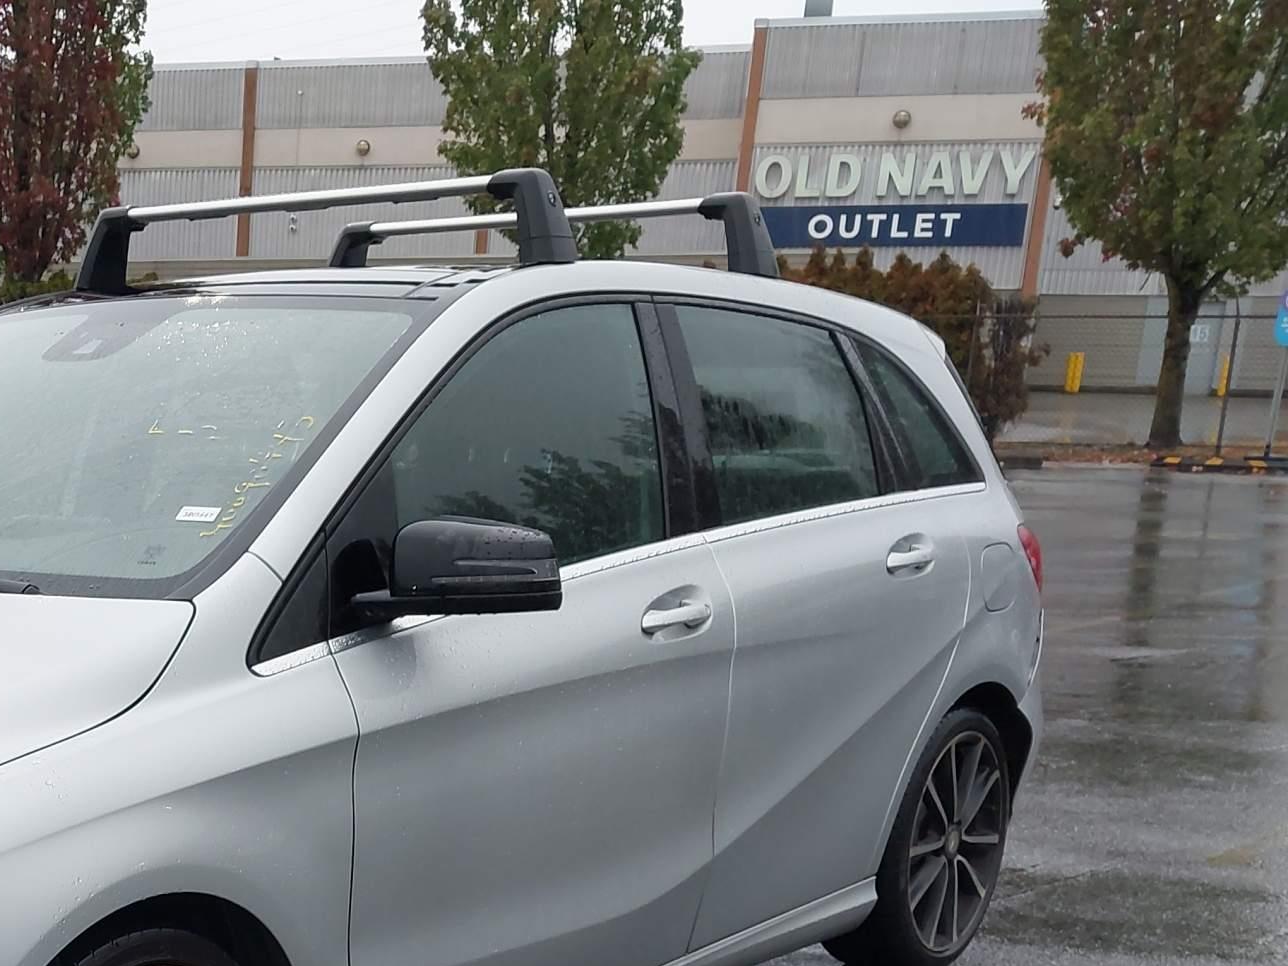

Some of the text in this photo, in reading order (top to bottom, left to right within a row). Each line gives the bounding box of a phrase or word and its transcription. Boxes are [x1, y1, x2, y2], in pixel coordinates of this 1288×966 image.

[755, 150, 1036, 199] OLD NAVY
[807, 212, 962, 239] OUTLET
